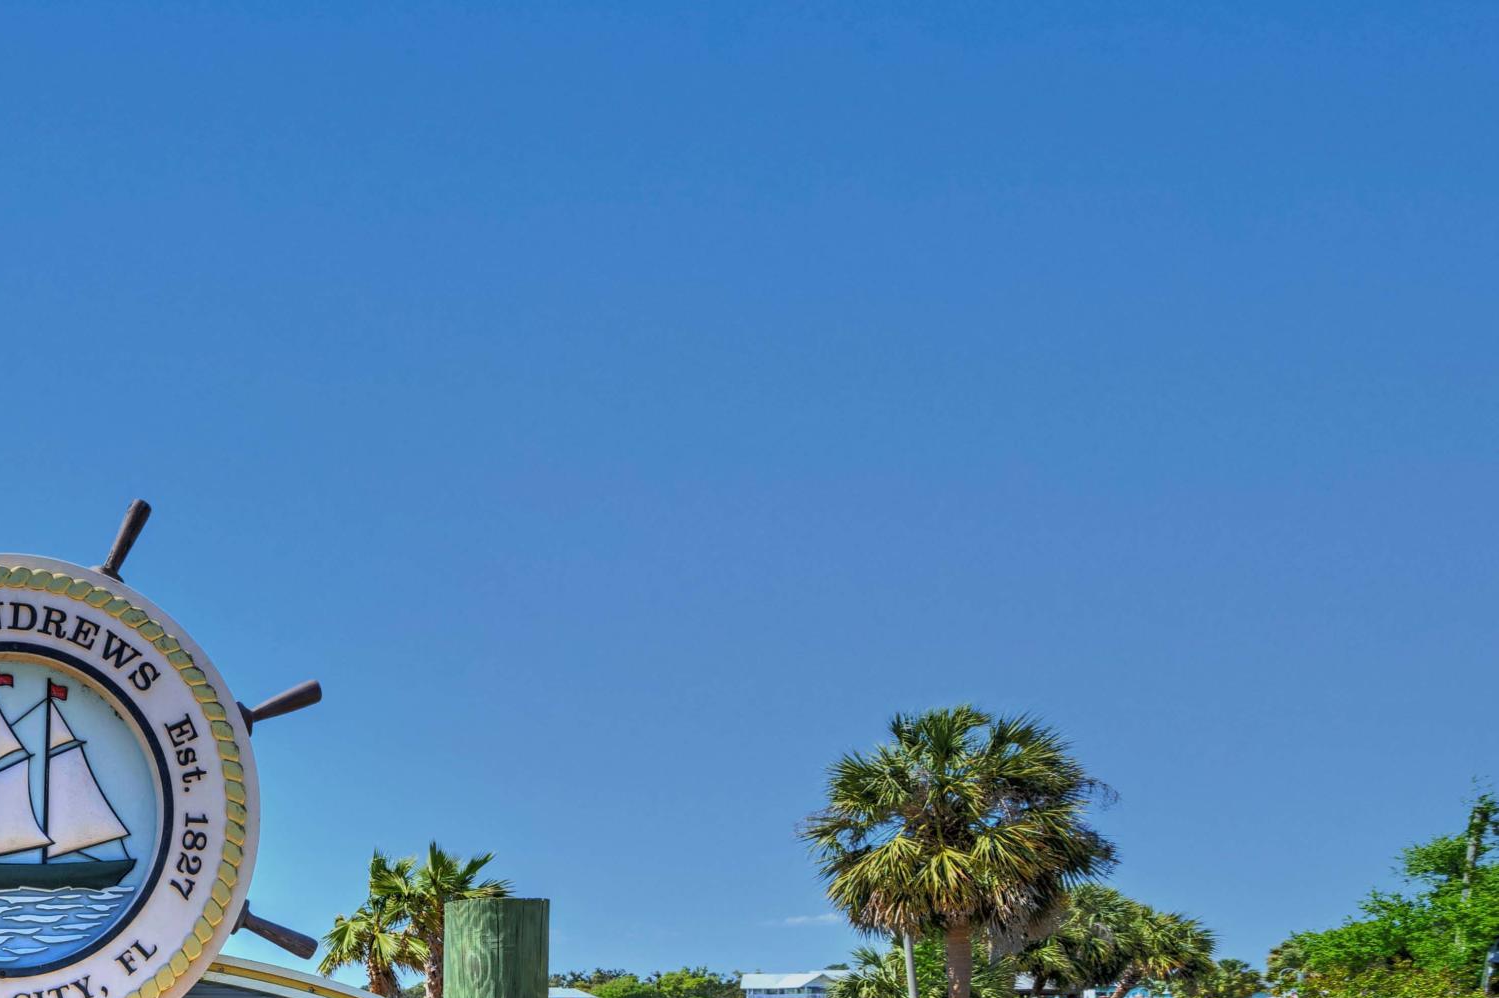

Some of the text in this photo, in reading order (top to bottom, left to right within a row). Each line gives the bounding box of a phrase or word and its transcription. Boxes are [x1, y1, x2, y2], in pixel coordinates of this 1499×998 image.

[164, 713, 208, 792] Est.
[170, 812, 209, 900] 1827
[115, 939, 157, 976] FL
